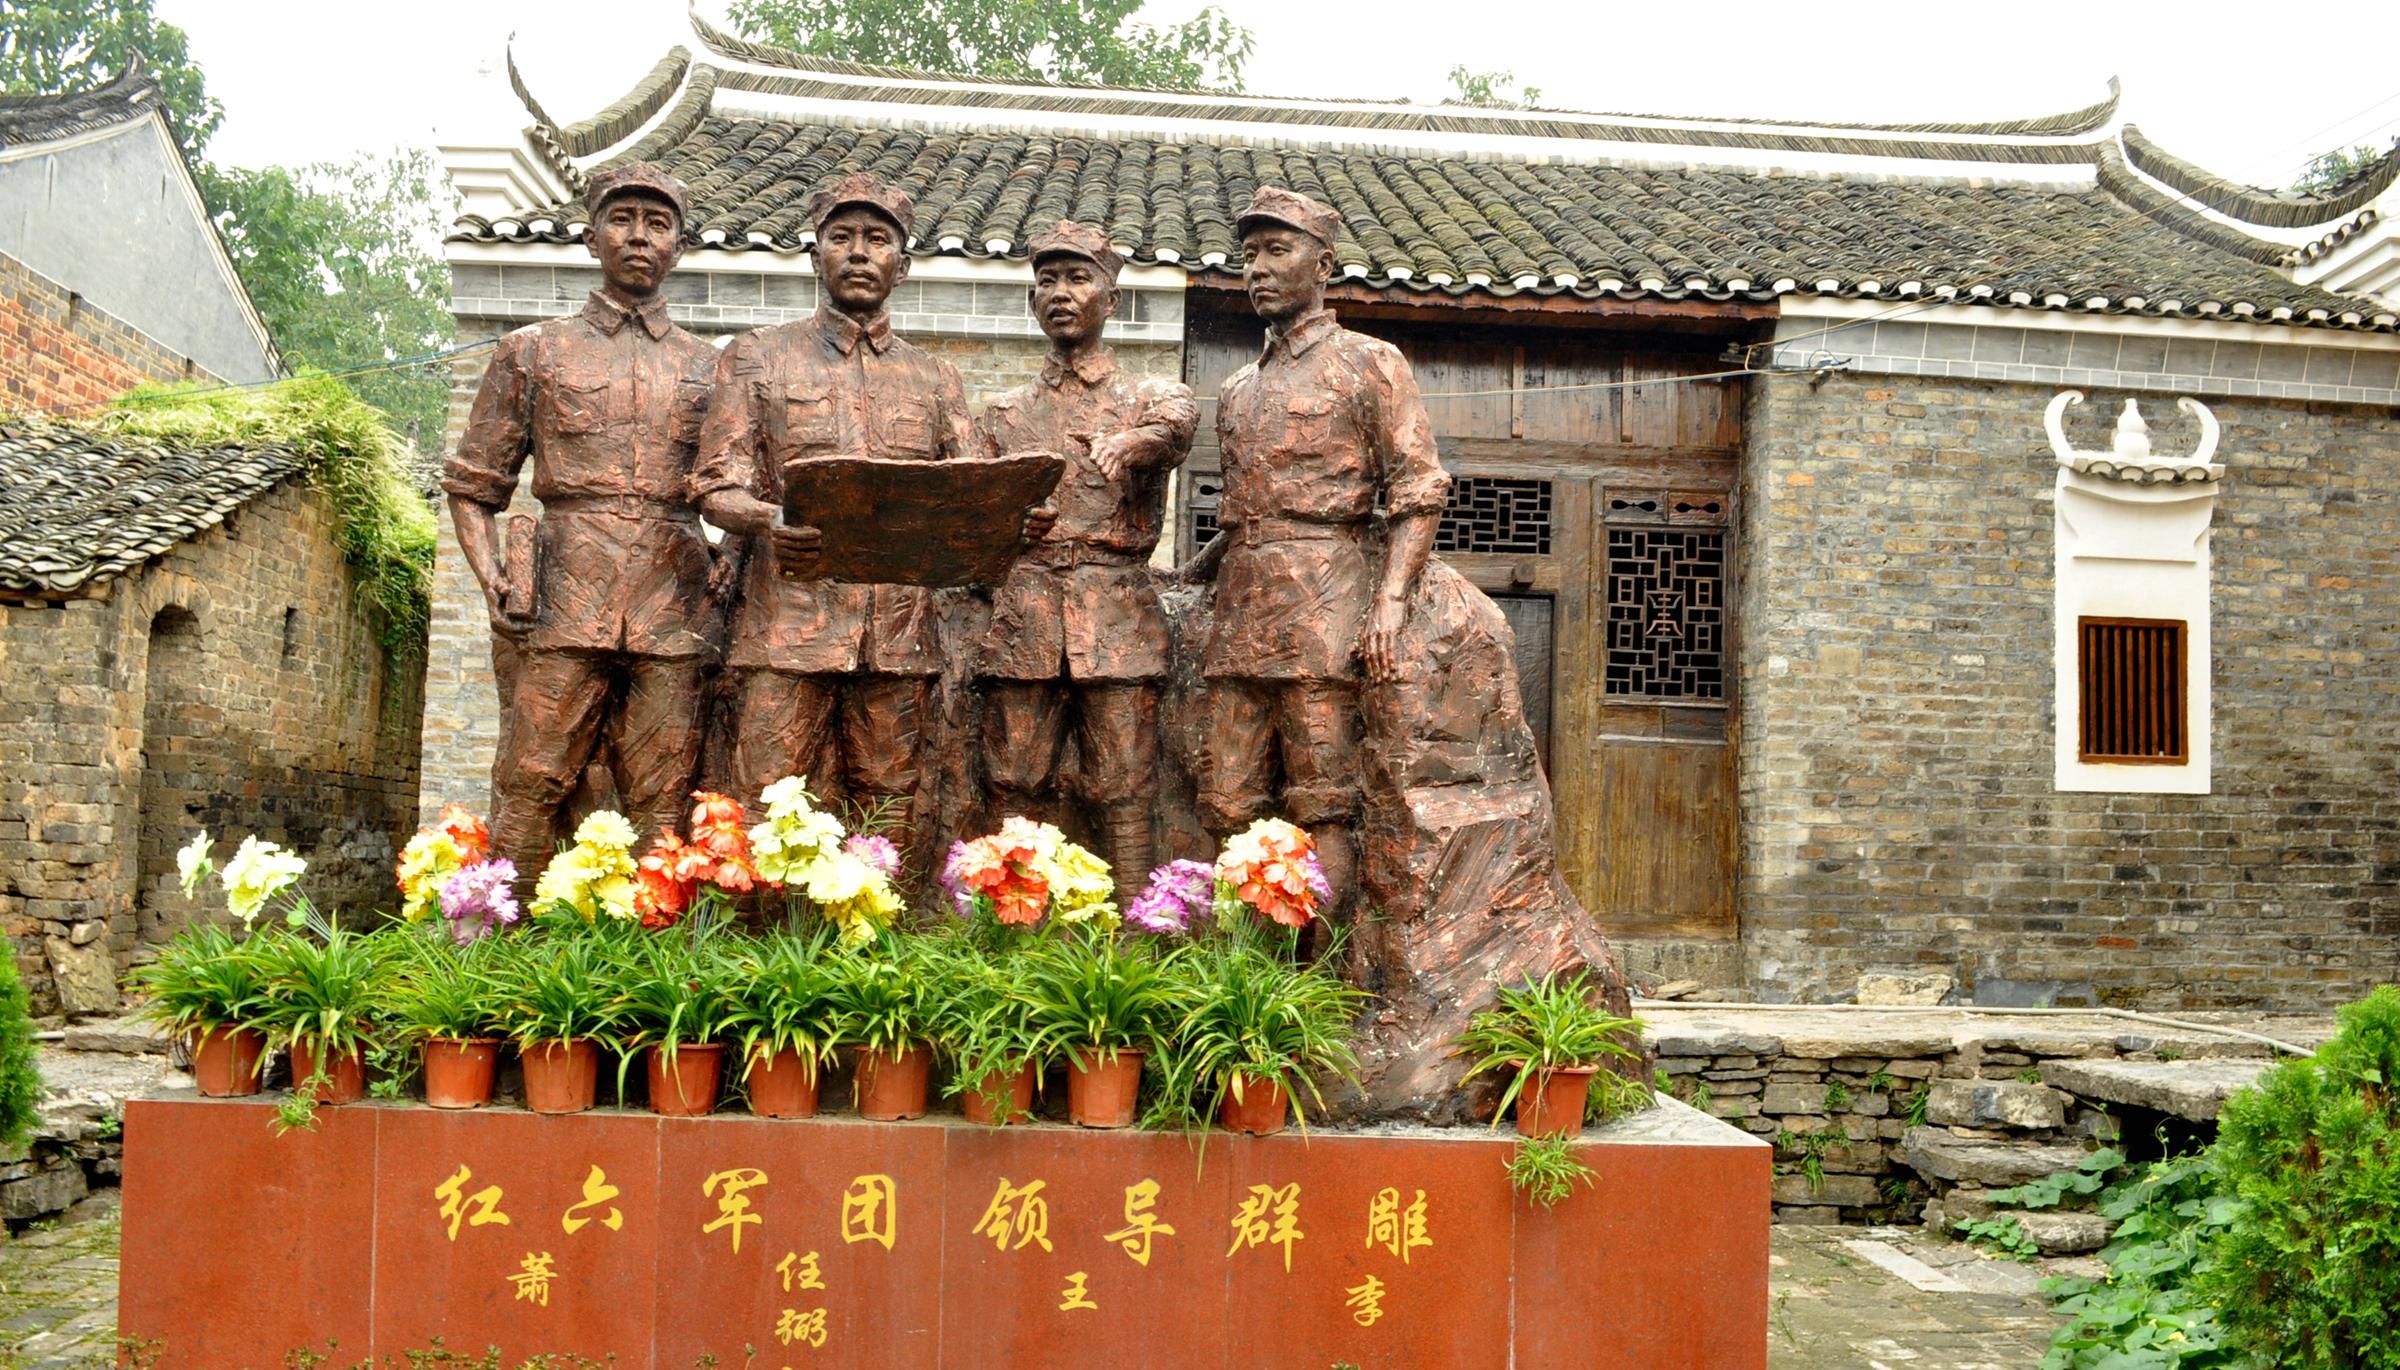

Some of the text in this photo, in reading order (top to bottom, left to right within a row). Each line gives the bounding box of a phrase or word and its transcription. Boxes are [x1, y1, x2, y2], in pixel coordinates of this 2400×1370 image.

[434, 1163, 1434, 1274] 红六军团领导群雕
[506, 1250, 559, 1307] 萧
[1058, 1270, 1099, 1312] 王
[1344, 1273, 1387, 1327] 李
[773, 1250, 829, 1370] 任弼
